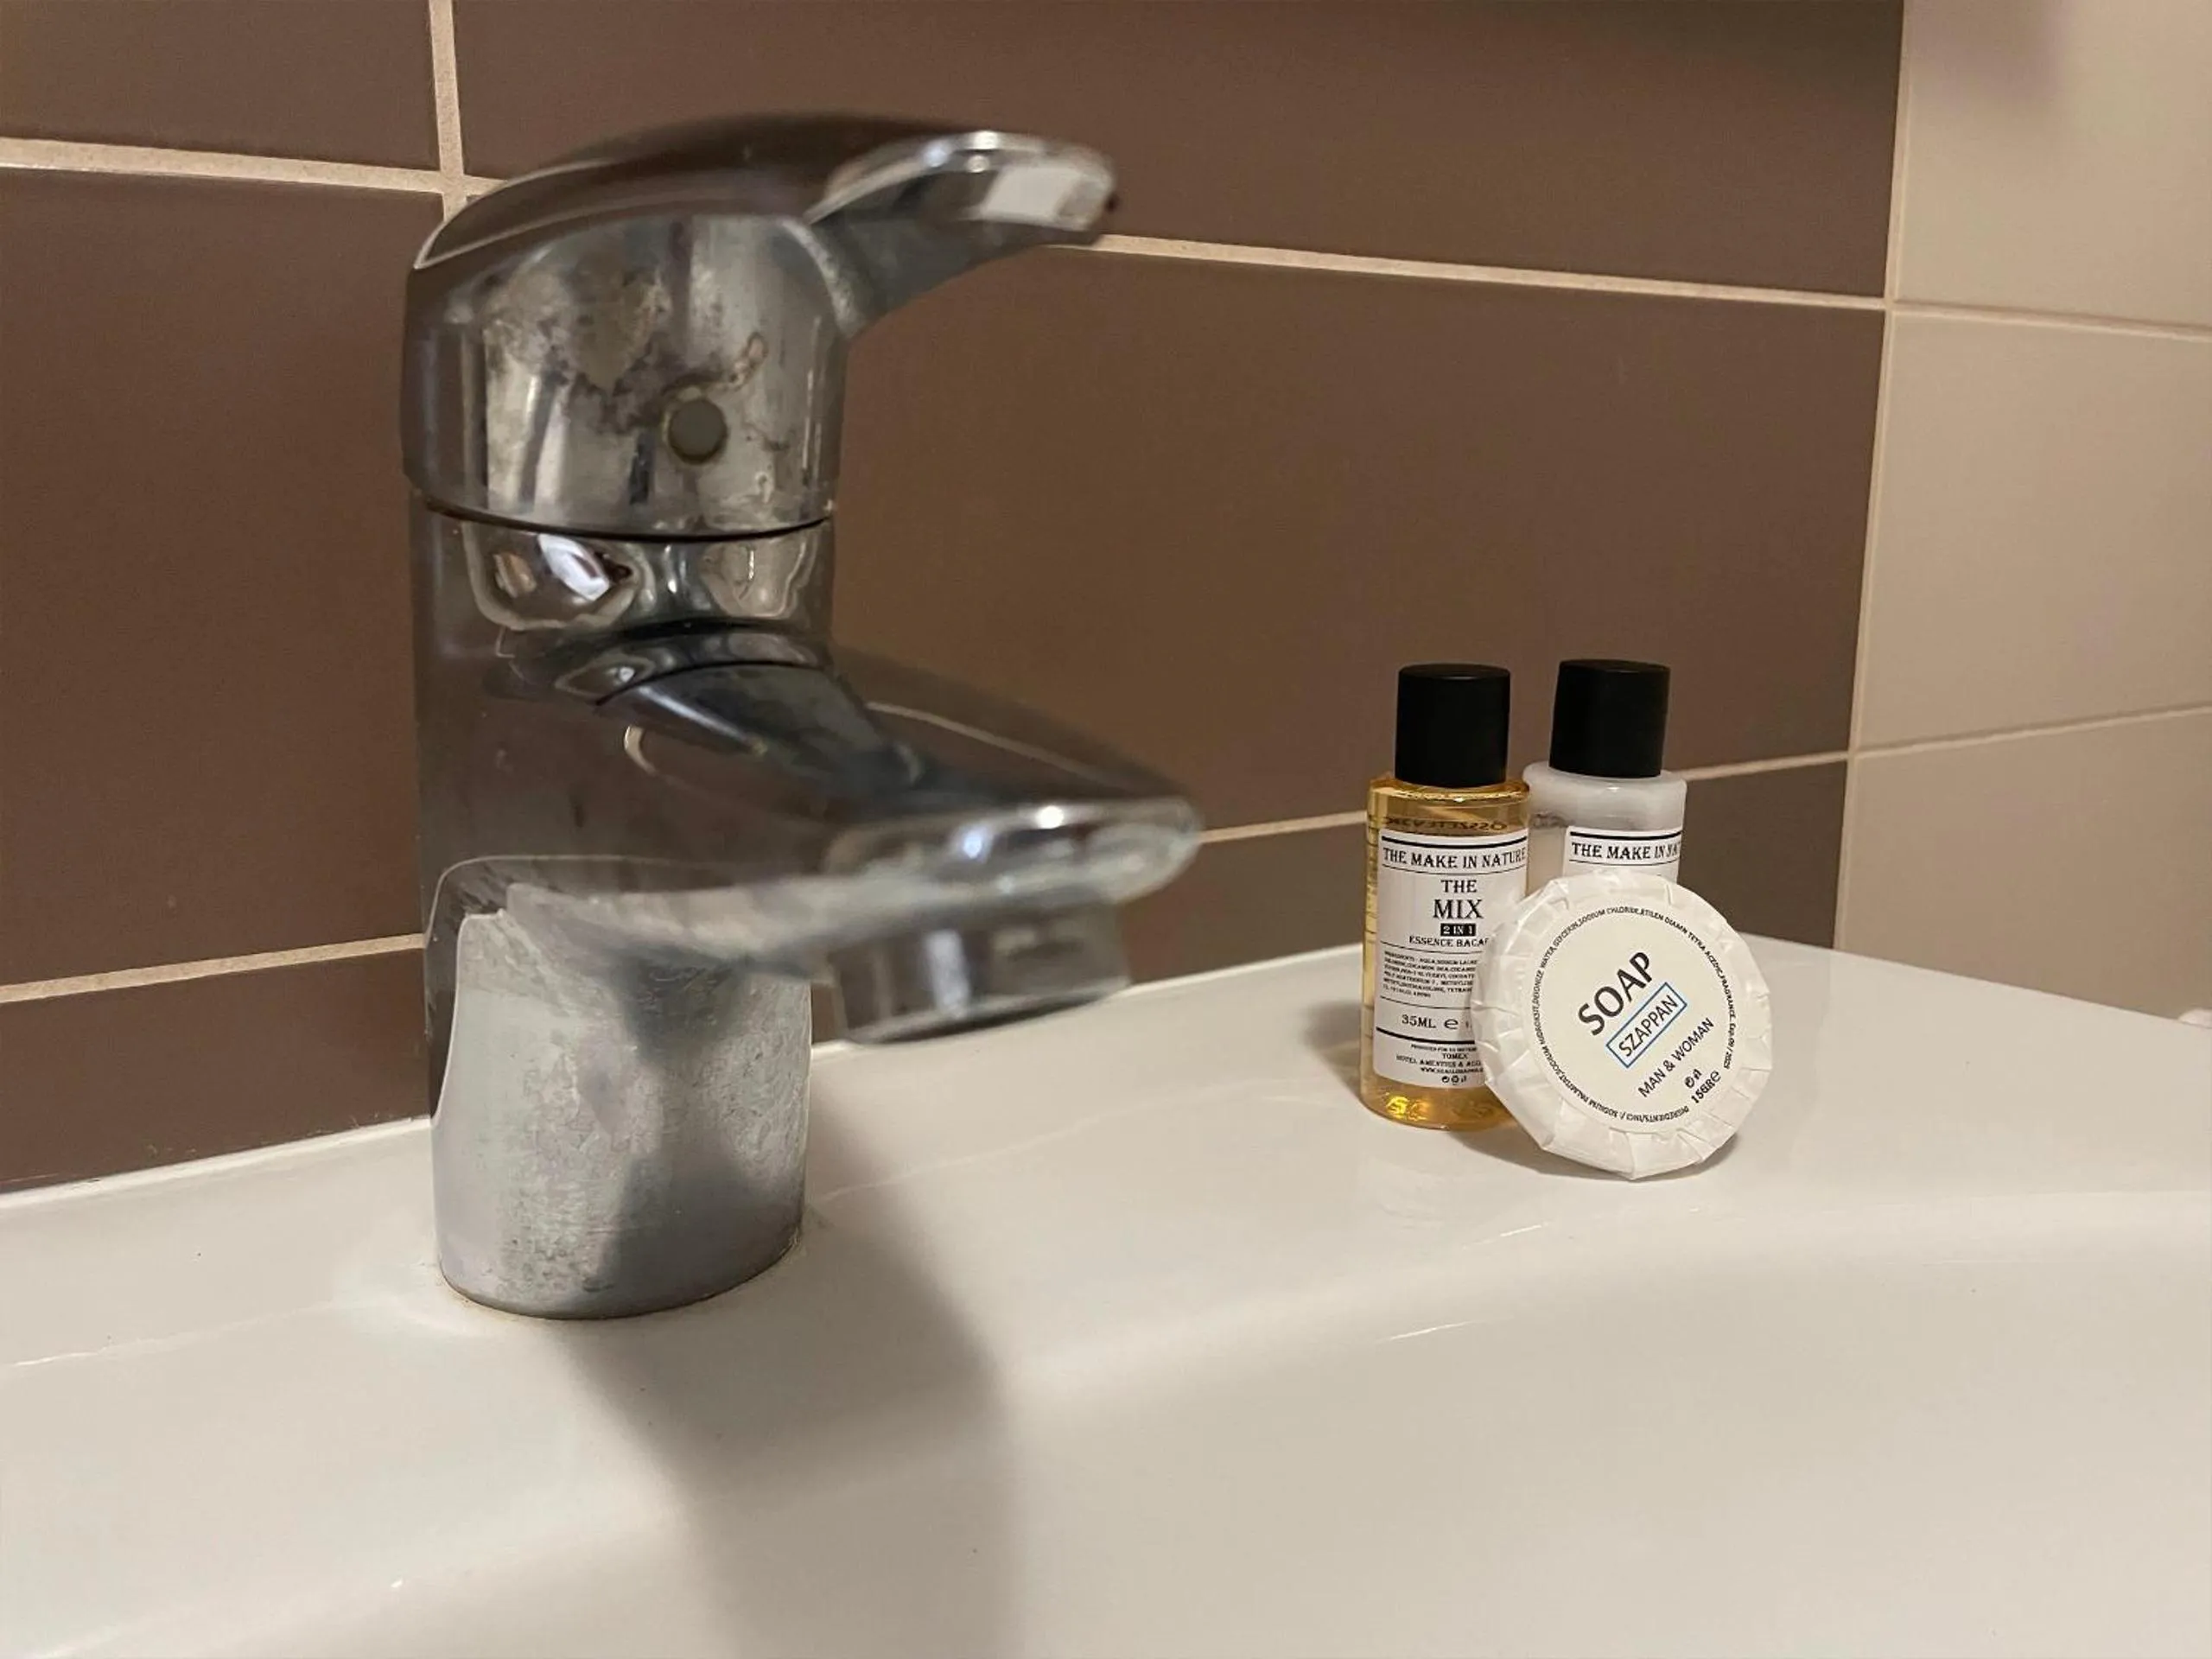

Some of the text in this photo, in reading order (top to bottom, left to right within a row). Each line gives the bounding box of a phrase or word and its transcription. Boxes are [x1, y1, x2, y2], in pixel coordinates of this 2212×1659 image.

[1383, 847, 1527, 868] THE MAKE IN NATURE
[1572, 842, 1602, 858] THE
[1606, 846, 1651, 860] MAKE
[1654, 845, 1666, 858] IN
[1440, 880, 1478, 893] THE
[1433, 899, 1484, 919] MIX
[1443, 925, 1473, 935] 2 IN 1
[1409, 936, 1453, 948] ESSENCE
[1578, 952, 1652, 1036] SOAP
[1402, 1014, 1437, 1029] 35ML
[1618, 995, 1678, 1057] SZAPPAN
[1396, 1055, 1417, 1065] HOTEL
[1637, 1017, 1714, 1097] MAN & WOMAN
